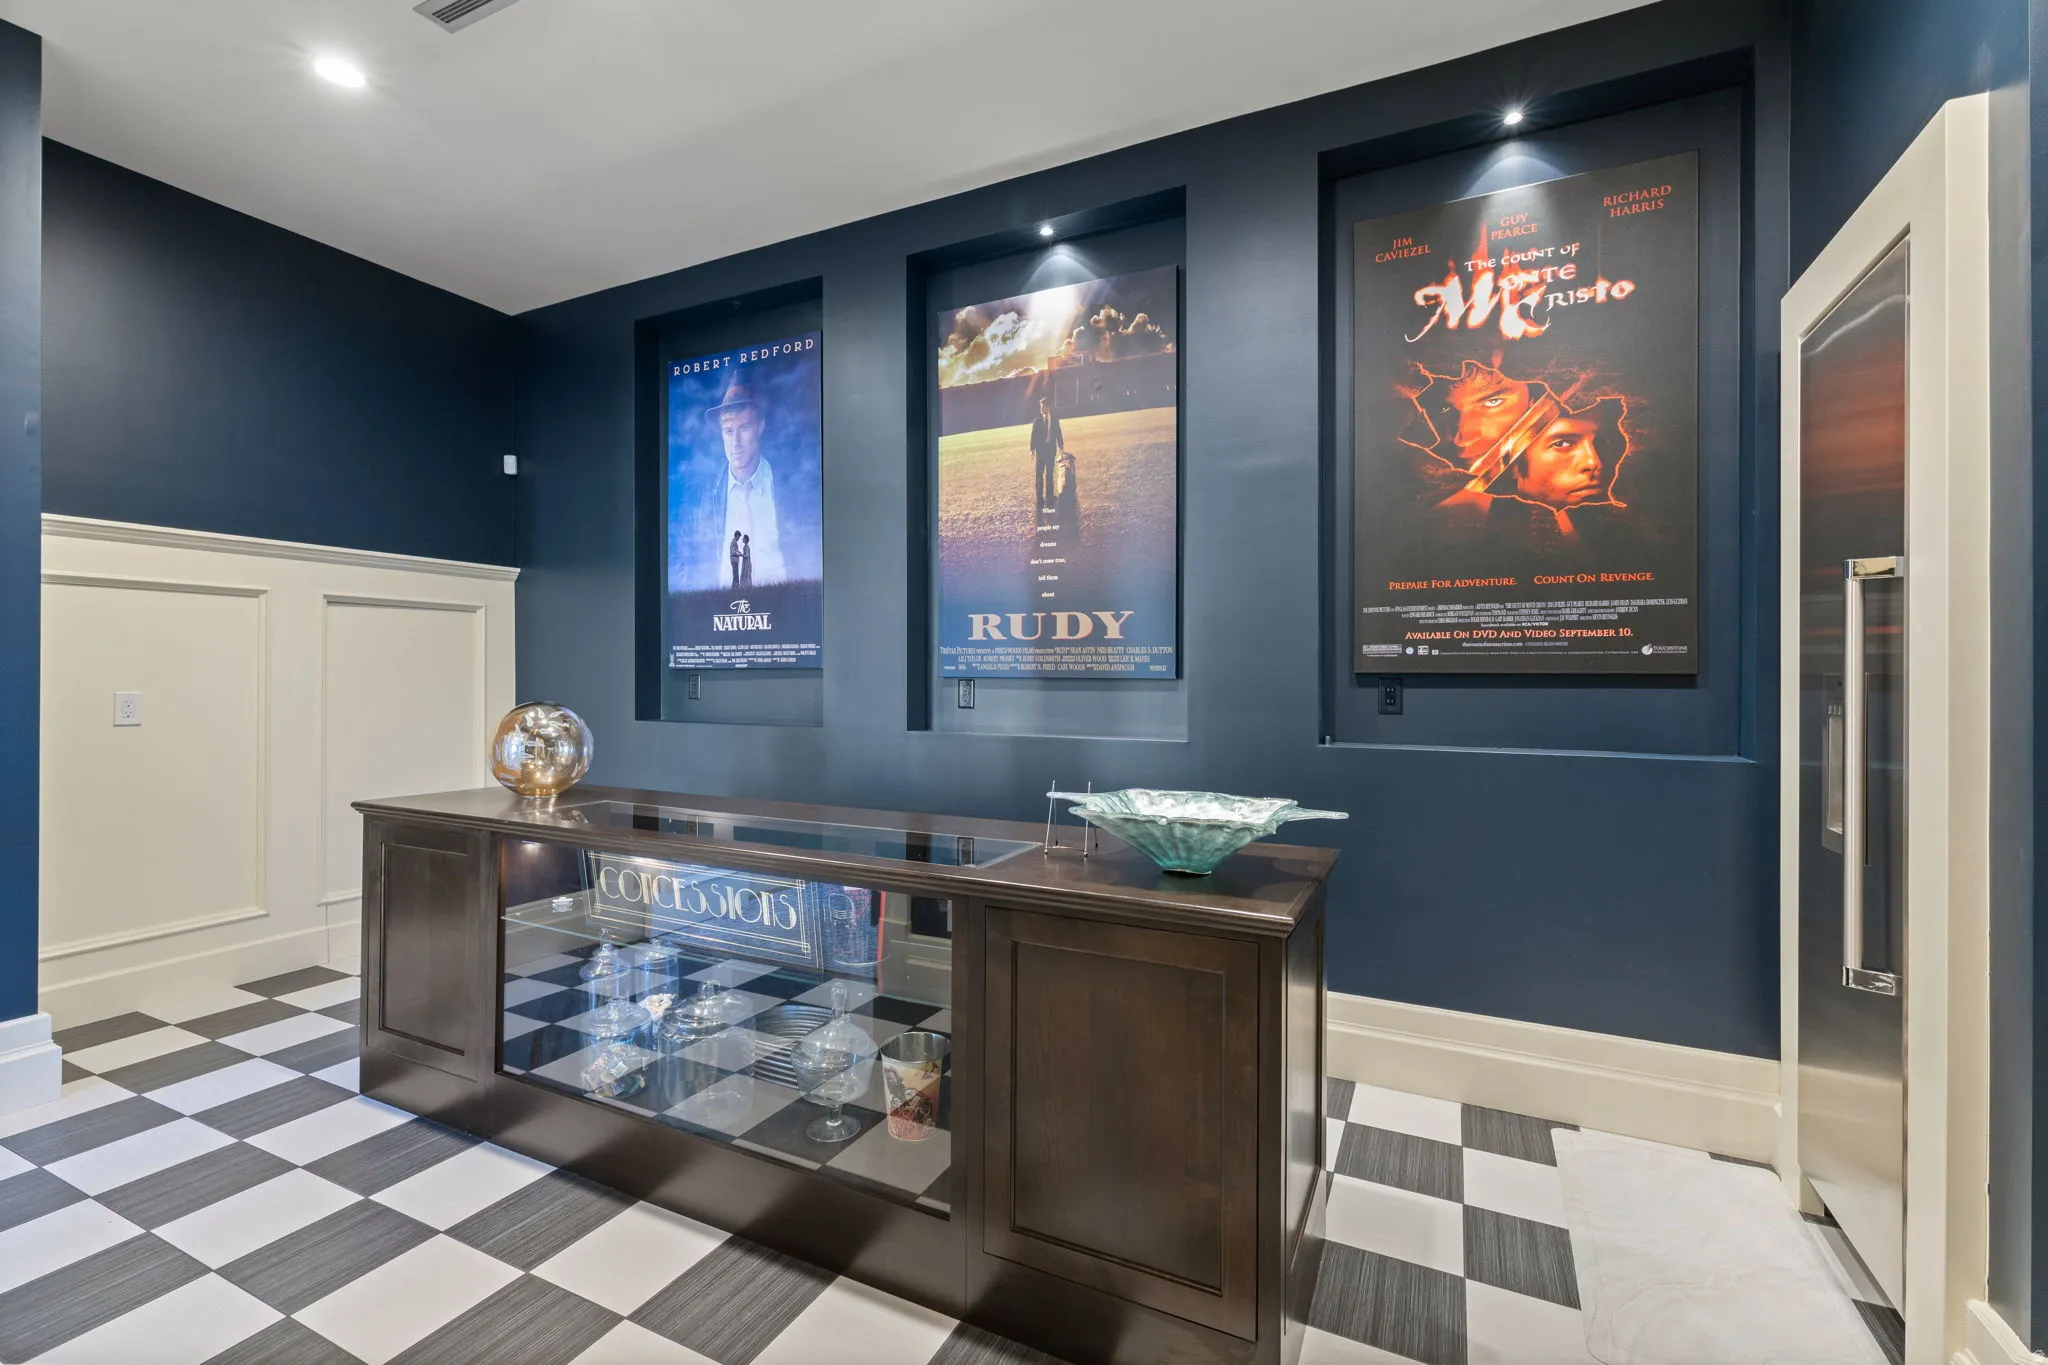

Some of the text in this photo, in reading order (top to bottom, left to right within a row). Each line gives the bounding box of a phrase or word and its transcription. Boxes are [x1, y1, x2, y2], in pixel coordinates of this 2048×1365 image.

[1603, 184, 1672, 207] RICHARD
[1609, 199, 1664, 218] HARRIS
[1499, 213, 1528, 227] GUY
[1491, 223, 1538, 241] PEARCE
[1392, 237, 1413, 250] JIM
[1375, 244, 1431, 263] CAVIEZEL
[1500, 246, 1555, 267] COUNT
[1560, 242, 1580, 258] OF
[1500, 280, 1635, 342] CRISTO
[673, 338, 814, 376] ROBERT REDFORD
[1389, 577, 1517, 590] PREPARE FOR ADVENTURE.
[1533, 572, 1655, 585] COUNT ON REVENGE.
[713, 615, 772, 631] NATURAL
[967, 610, 1135, 641] RUDY
[1405, 627, 1634, 640] AVAILABLE ON DVD AND VIDEO SEPTEMBER 10.
